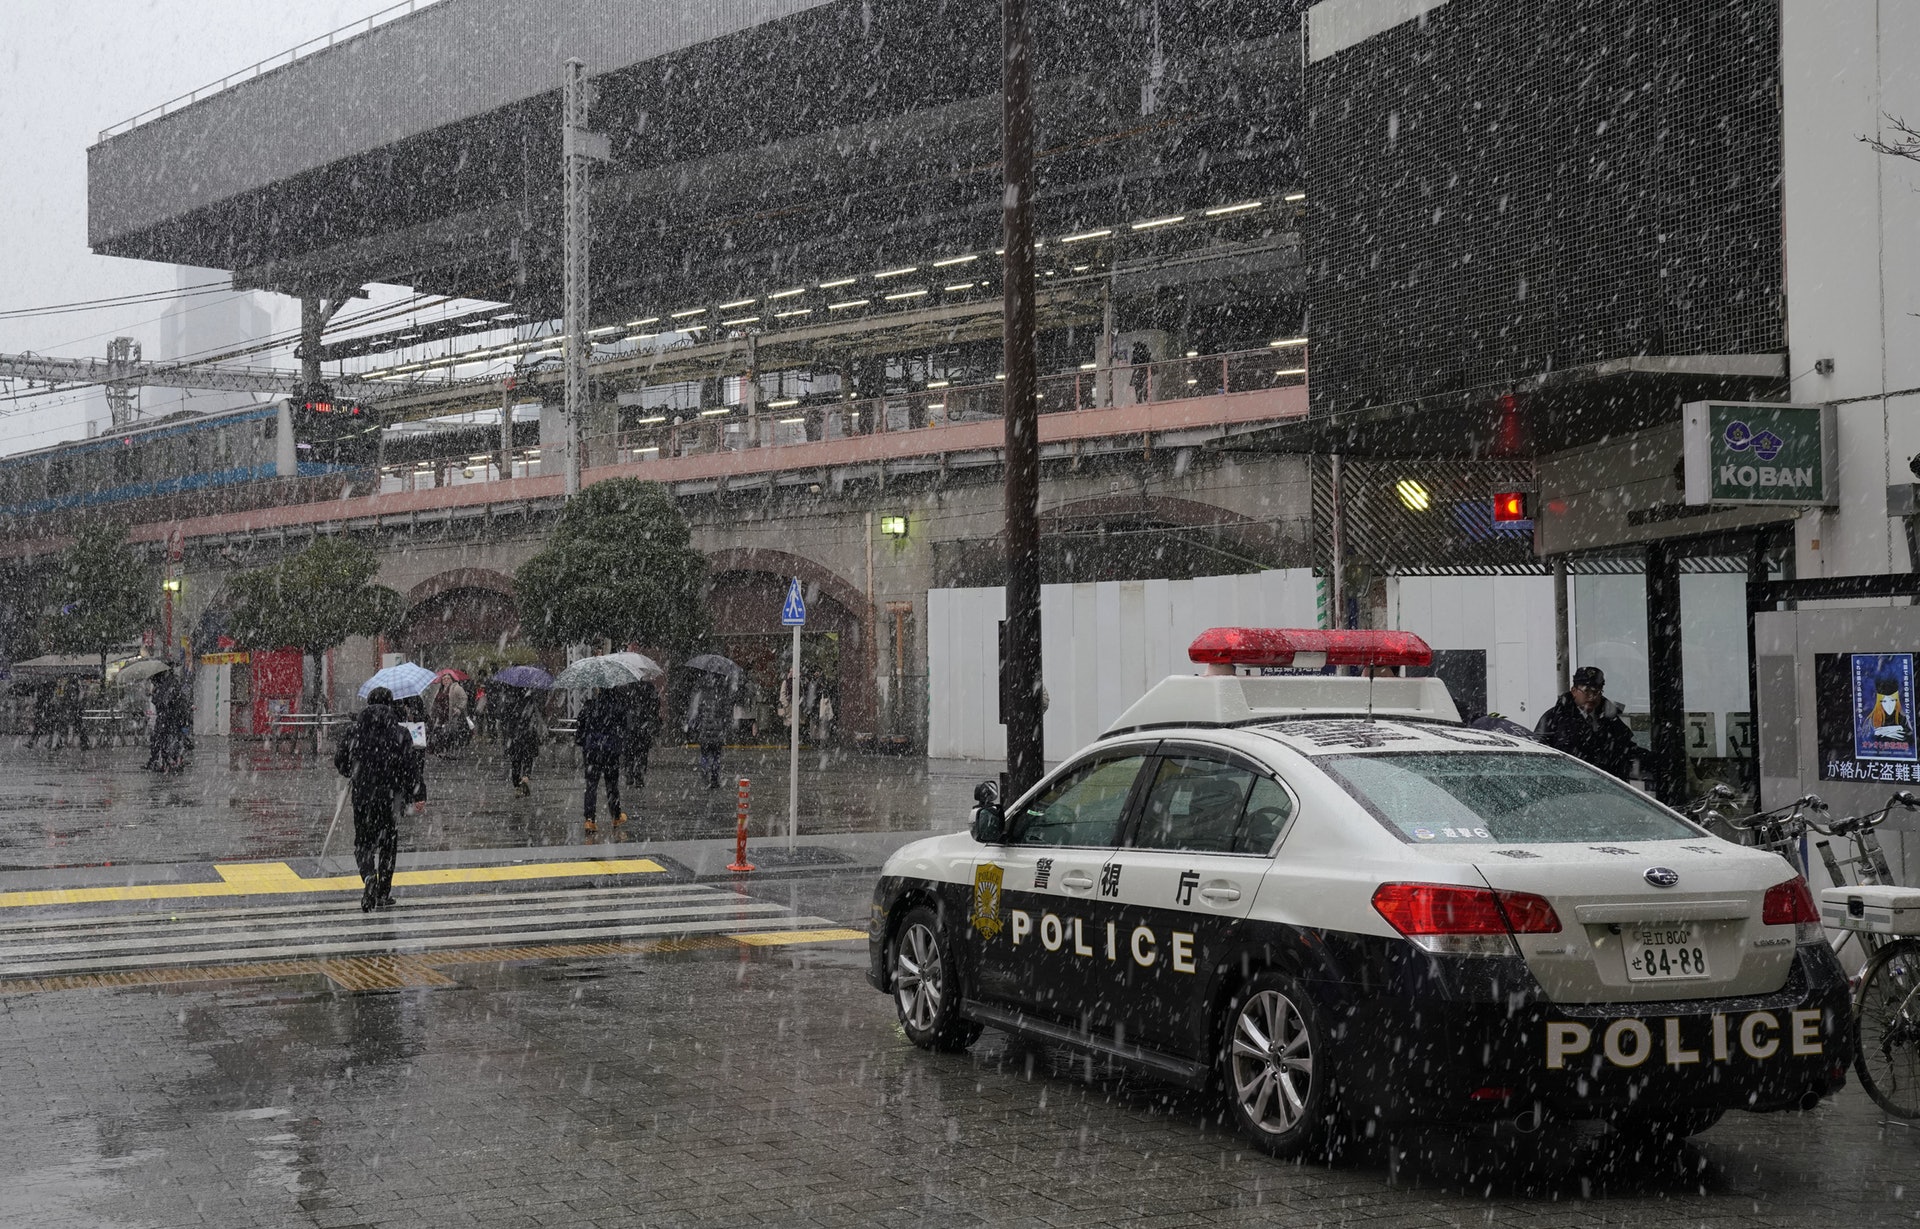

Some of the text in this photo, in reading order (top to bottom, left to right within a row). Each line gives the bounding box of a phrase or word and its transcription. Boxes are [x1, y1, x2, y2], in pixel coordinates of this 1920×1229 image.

[1720, 465, 1813, 487] KOBAN
[1827, 760, 1920, 782] が絡んだ盗難事
[1011, 908, 1196, 974] POLICE
[1642, 931, 1688, 945] 足立 800
[1631, 948, 1705, 976] せ 84-88
[1546, 1008, 1823, 1069] POLICE
